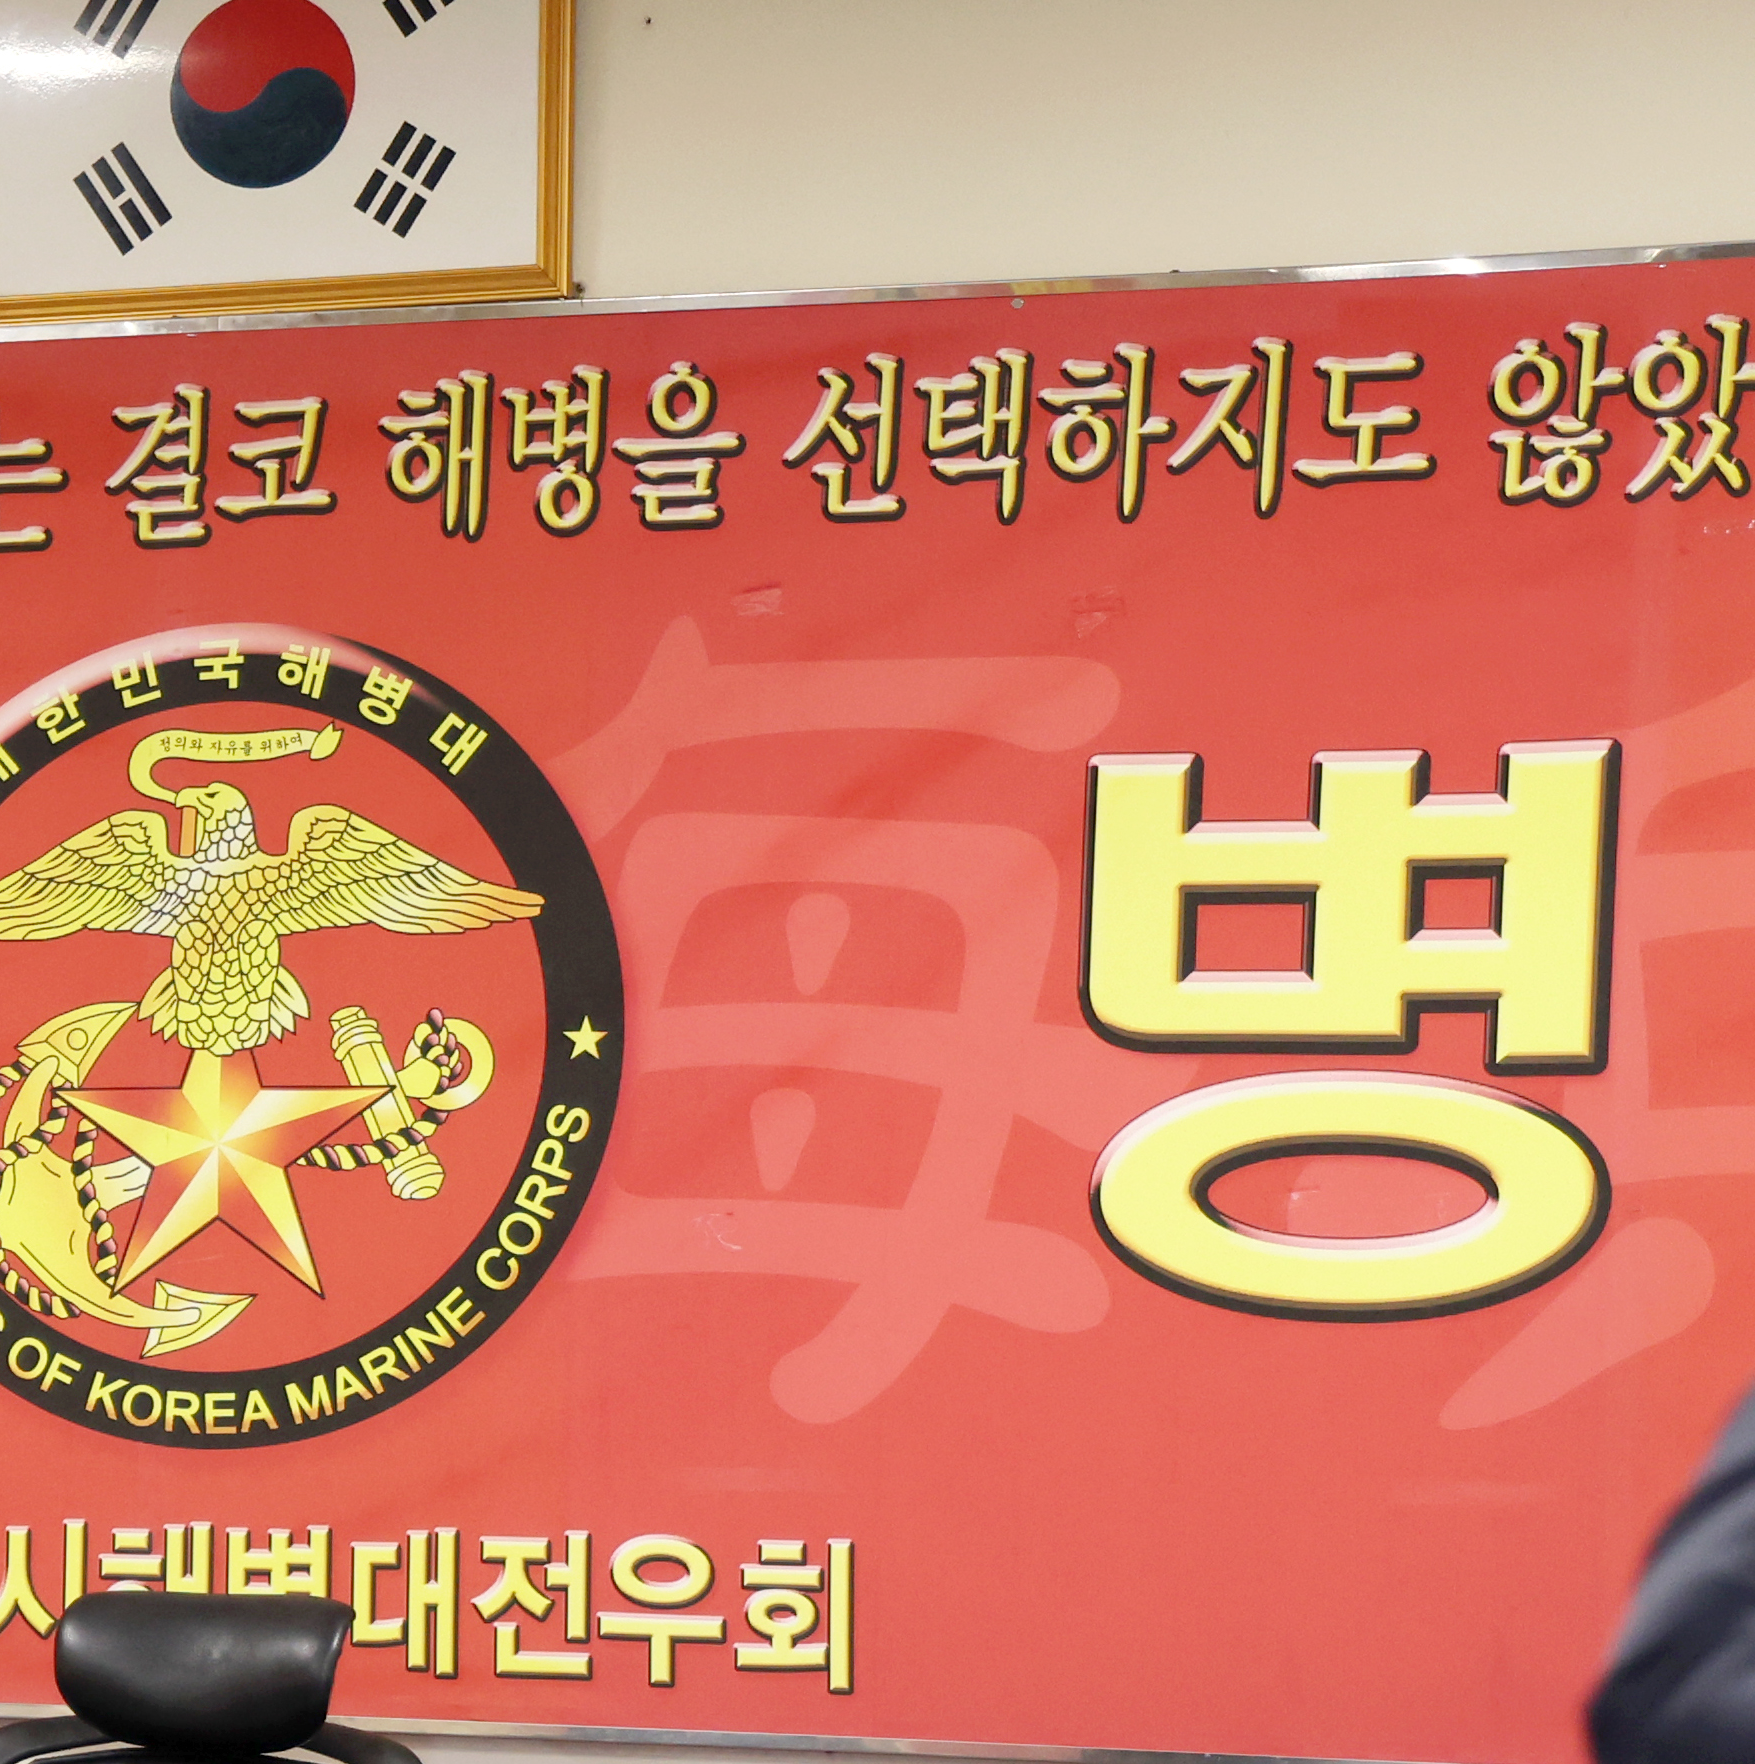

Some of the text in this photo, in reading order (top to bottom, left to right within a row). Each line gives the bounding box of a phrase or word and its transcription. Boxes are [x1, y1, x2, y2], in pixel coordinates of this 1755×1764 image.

[105, 384, 337, 545] 결코
[378, 362, 747, 542] 해병을
[785, 337, 1436, 522] 선택하지도
[1489, 314, 1755, 508] 않았
[159, 732, 303, 756] 정의와 자유를 위하여
[6, 1337, 82, 1394] OF
[84, 1370, 279, 1435] KOREA
[283, 1286, 488, 1426] MARINE
[474, 1103, 591, 1292] CORPS
